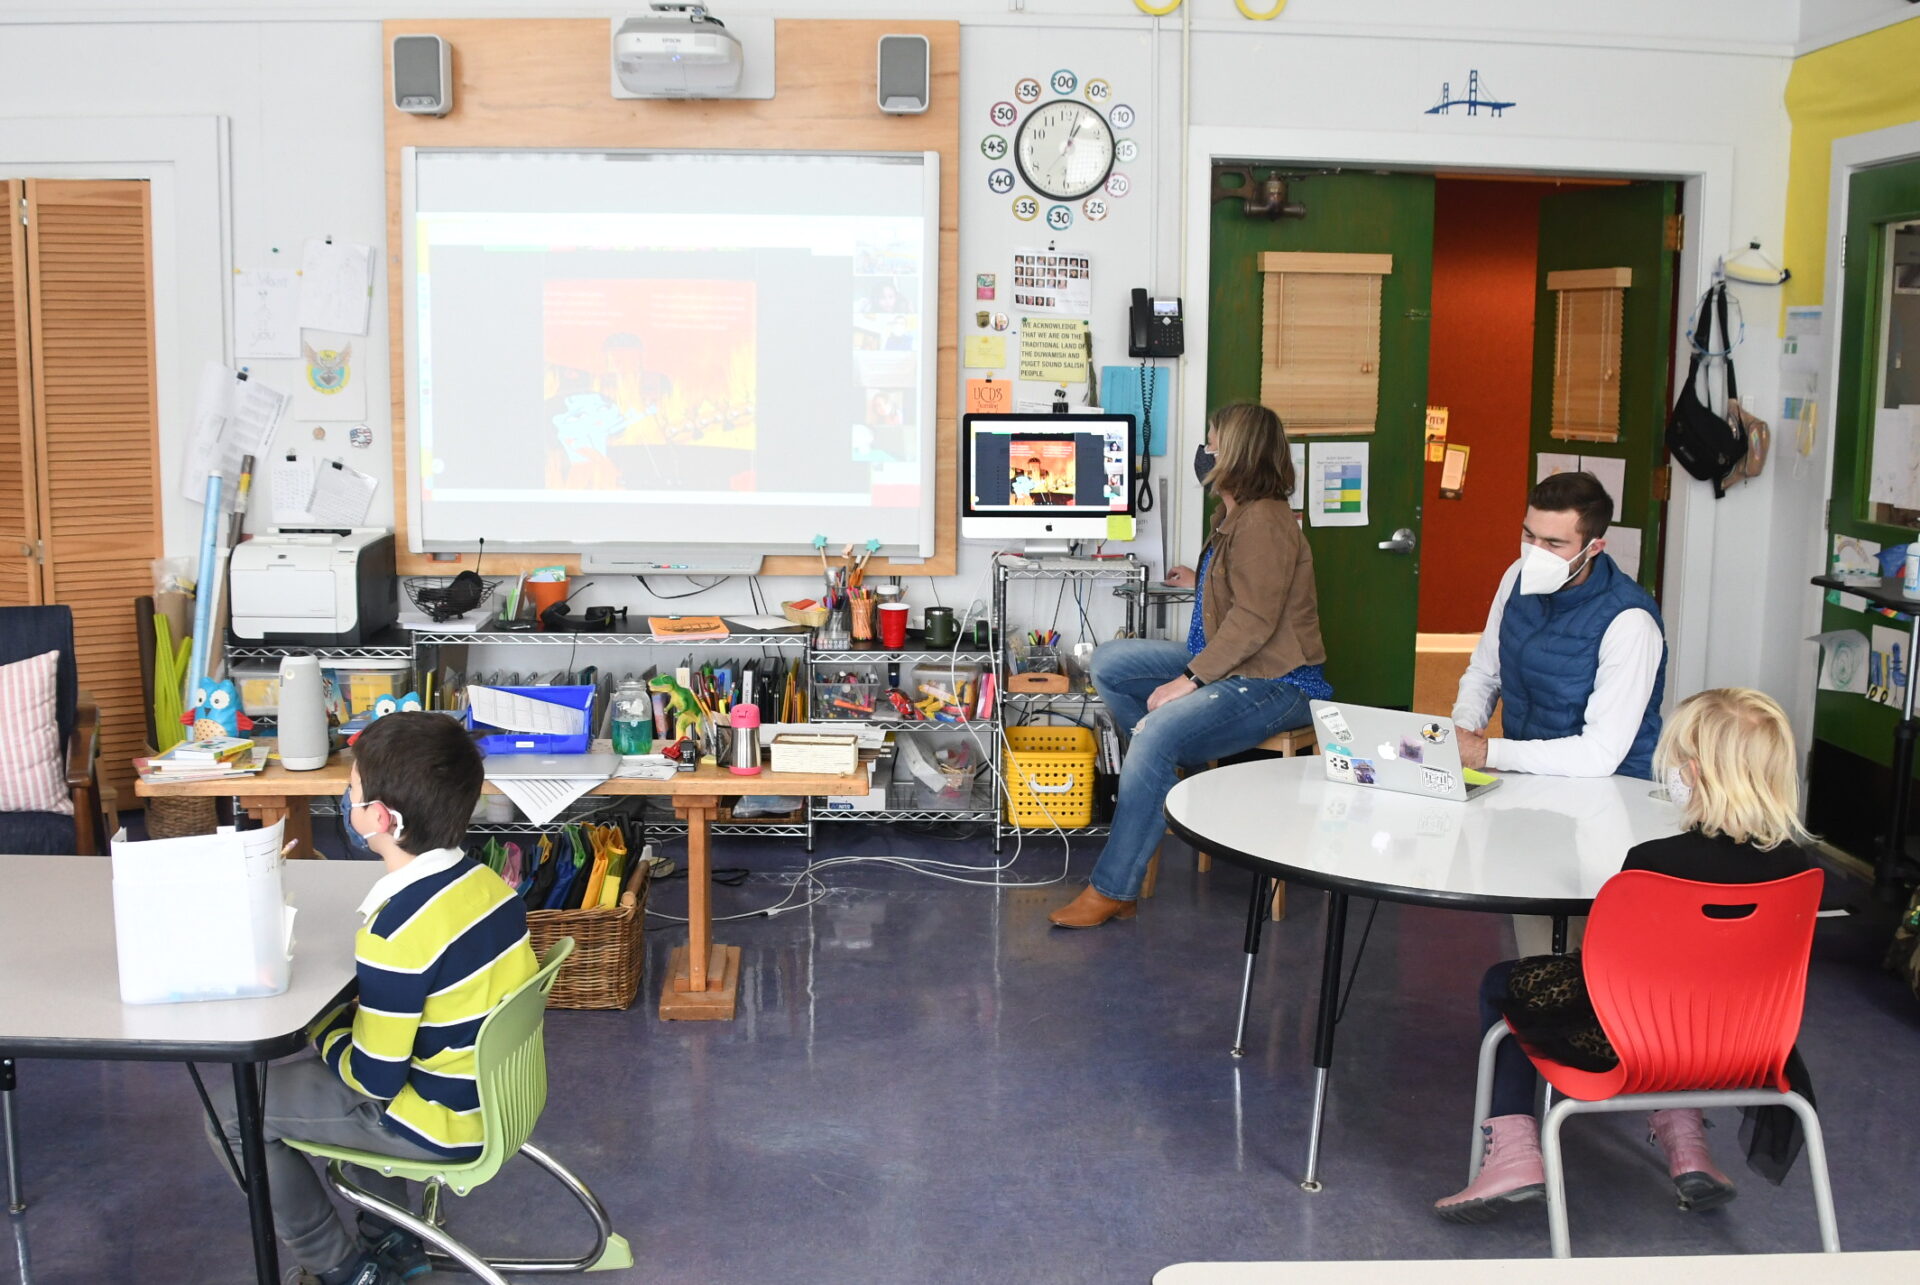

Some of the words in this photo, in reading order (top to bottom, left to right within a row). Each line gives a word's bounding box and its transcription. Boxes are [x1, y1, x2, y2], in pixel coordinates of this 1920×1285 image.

[1018, 85, 1038, 96] :55
[1016, 202, 1036, 214] :35
[1049, 212, 1070, 224] :30
